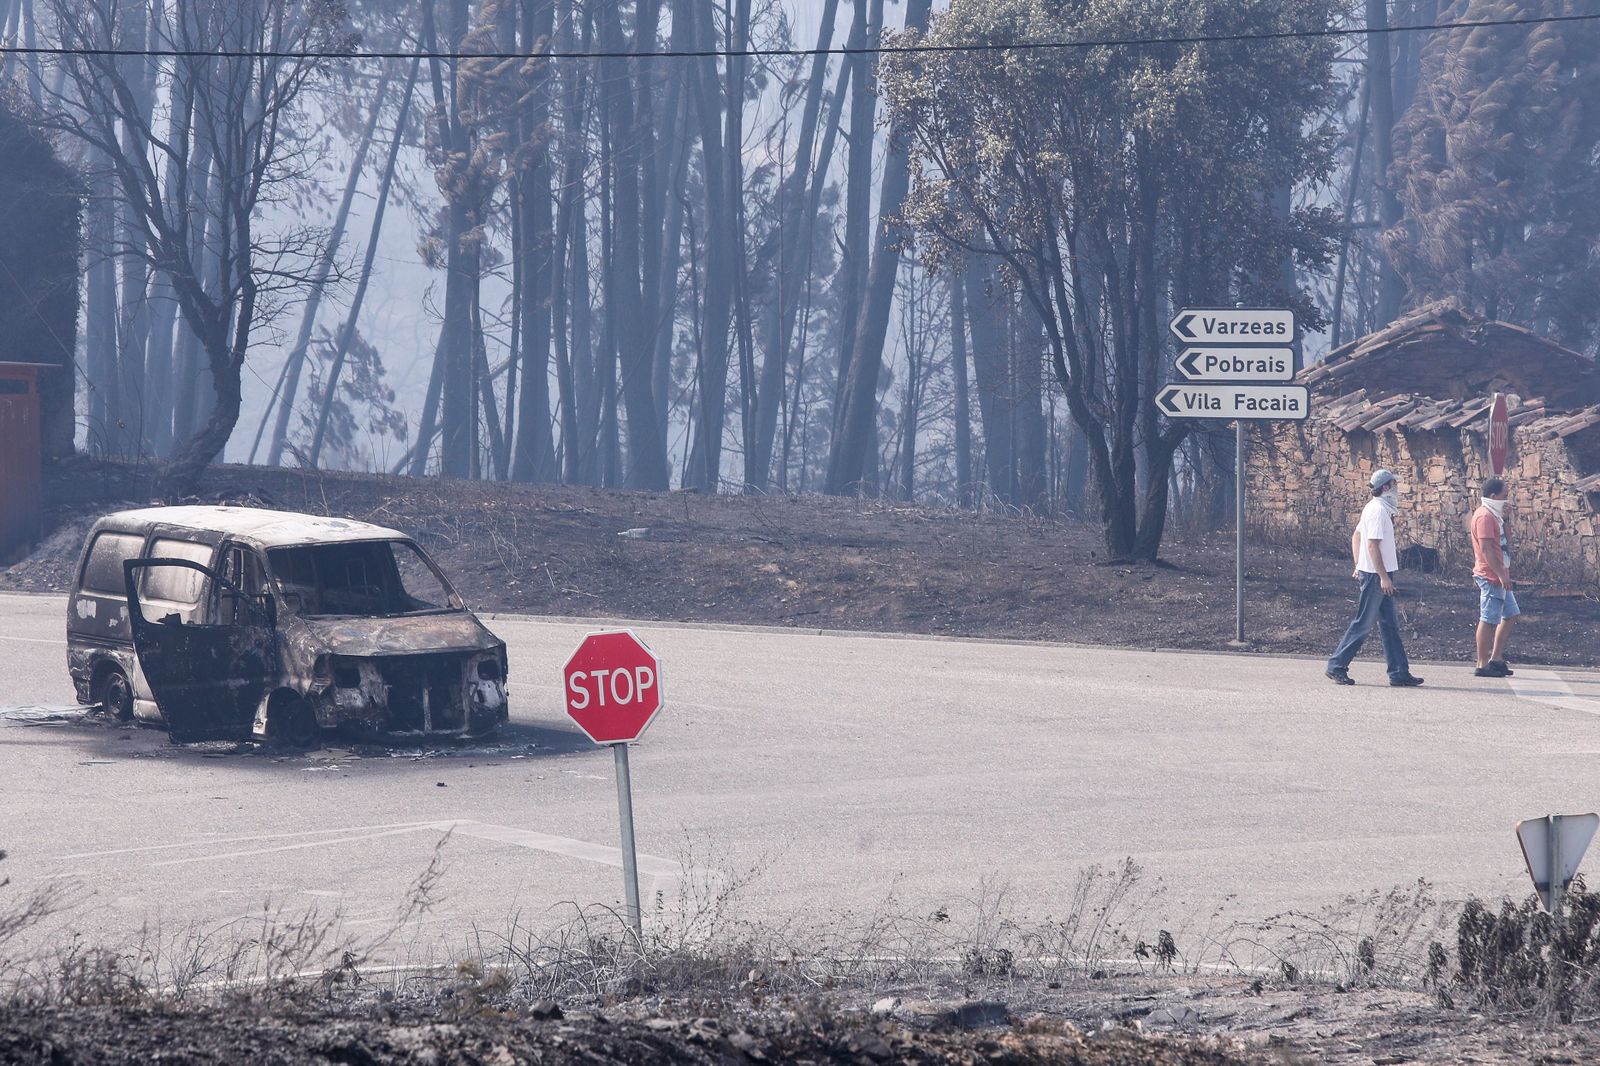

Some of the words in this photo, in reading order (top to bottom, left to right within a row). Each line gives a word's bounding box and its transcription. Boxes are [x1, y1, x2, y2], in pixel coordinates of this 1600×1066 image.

[1202, 317, 1286, 335] Varzeas
[1205, 355, 1285, 373] Pobrais
[1183, 393, 1222, 410] Vila
[1234, 393, 1299, 411] Facaia
[1491, 421, 1508, 449] STOP
[569, 666, 654, 710] STOP
